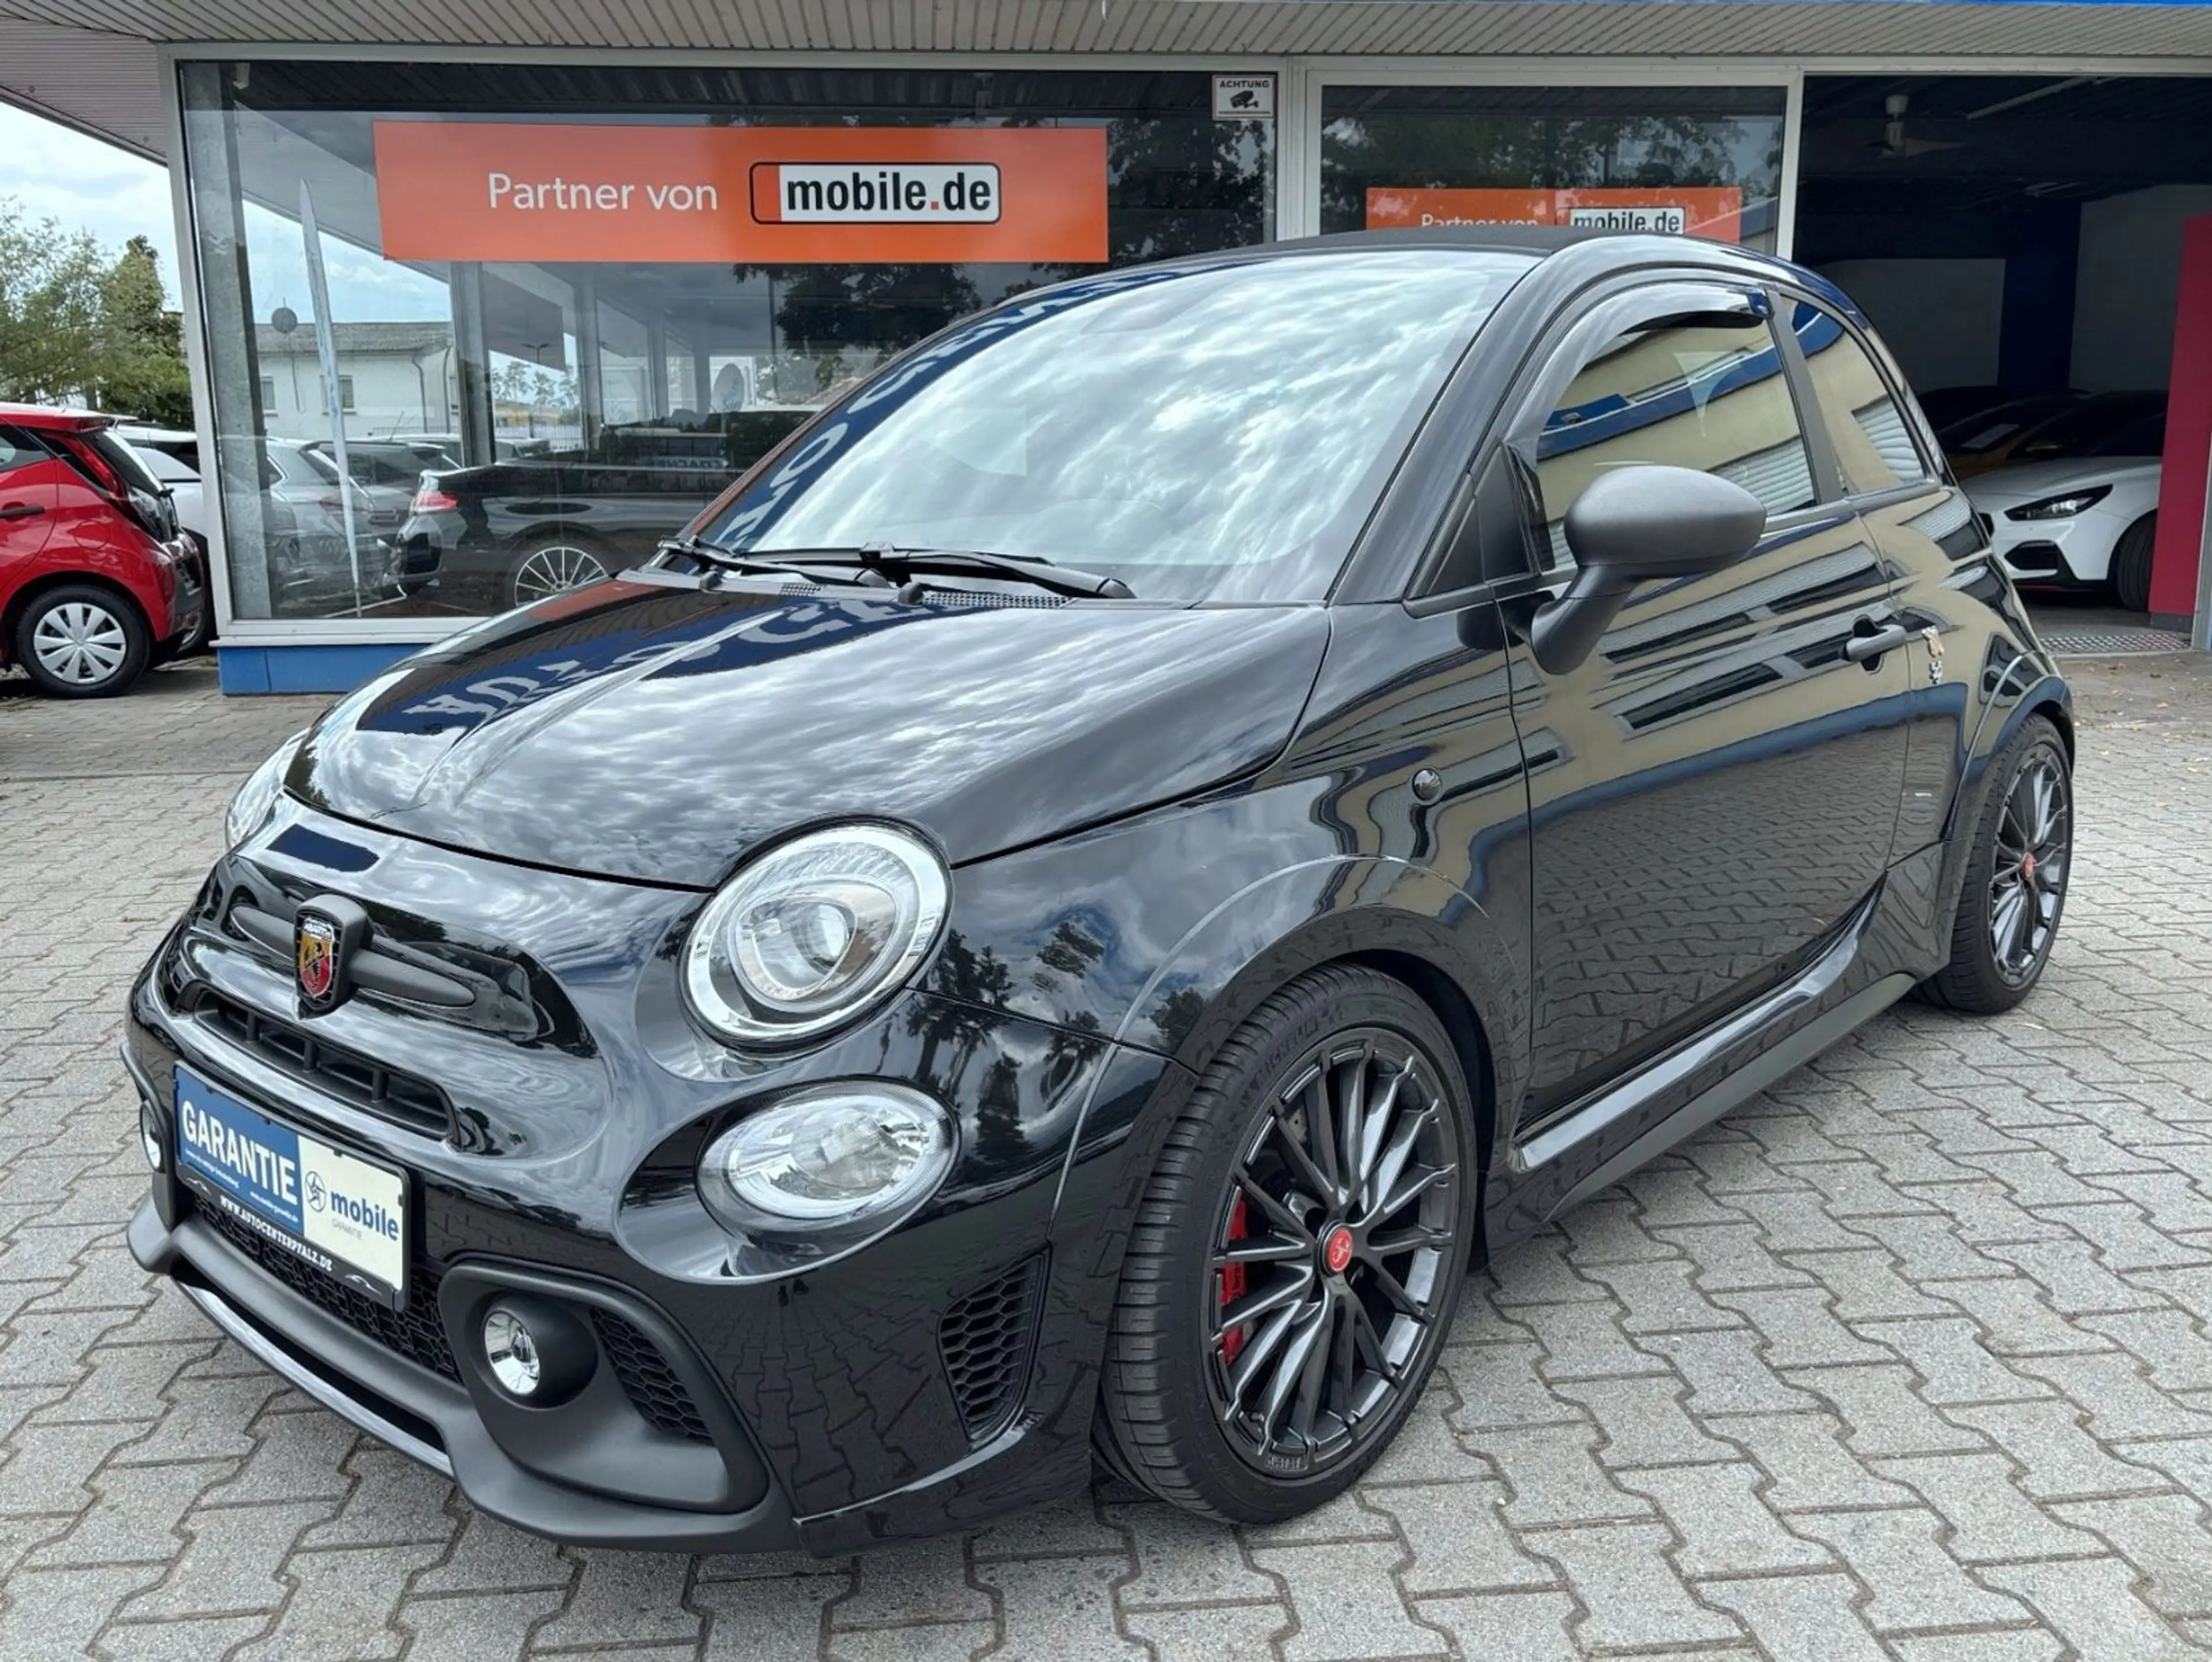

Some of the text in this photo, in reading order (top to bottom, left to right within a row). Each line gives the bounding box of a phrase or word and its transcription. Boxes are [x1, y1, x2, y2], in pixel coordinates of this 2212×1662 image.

[1219, 80, 1270, 88] ACHTUNG
[488, 171, 991, 211] Partner von mobile.de
[182, 1100, 298, 1206] GARANTIE
[331, 1191, 399, 1241] mobile
